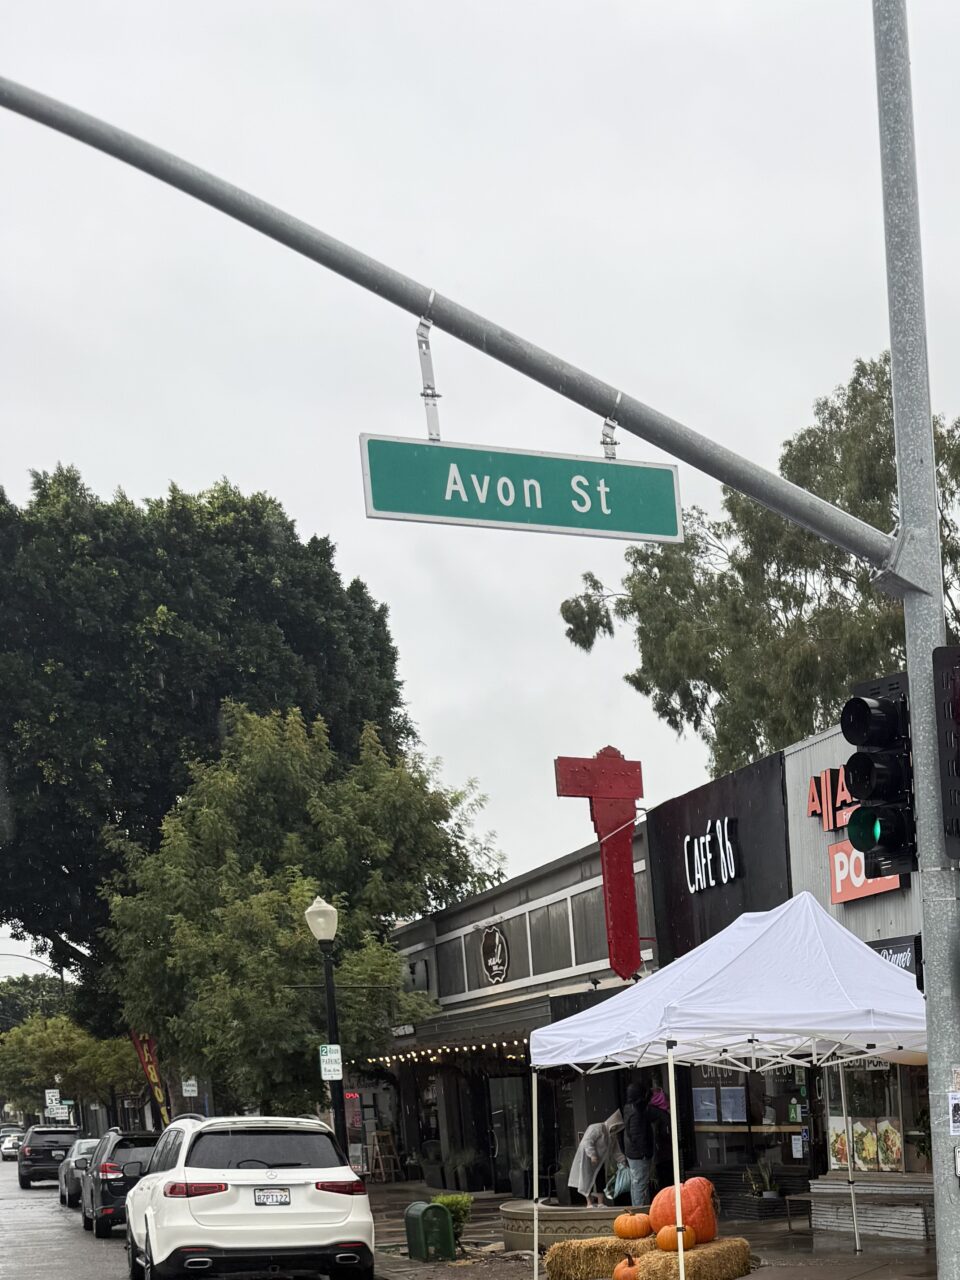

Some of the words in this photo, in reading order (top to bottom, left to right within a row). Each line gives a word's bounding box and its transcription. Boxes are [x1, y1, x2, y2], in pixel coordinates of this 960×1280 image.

[445, 463, 543, 509] Avon
[570, 475, 612, 515] St
[684, 819, 716, 894] CAFÉ
[716, 816, 735, 884] 86
